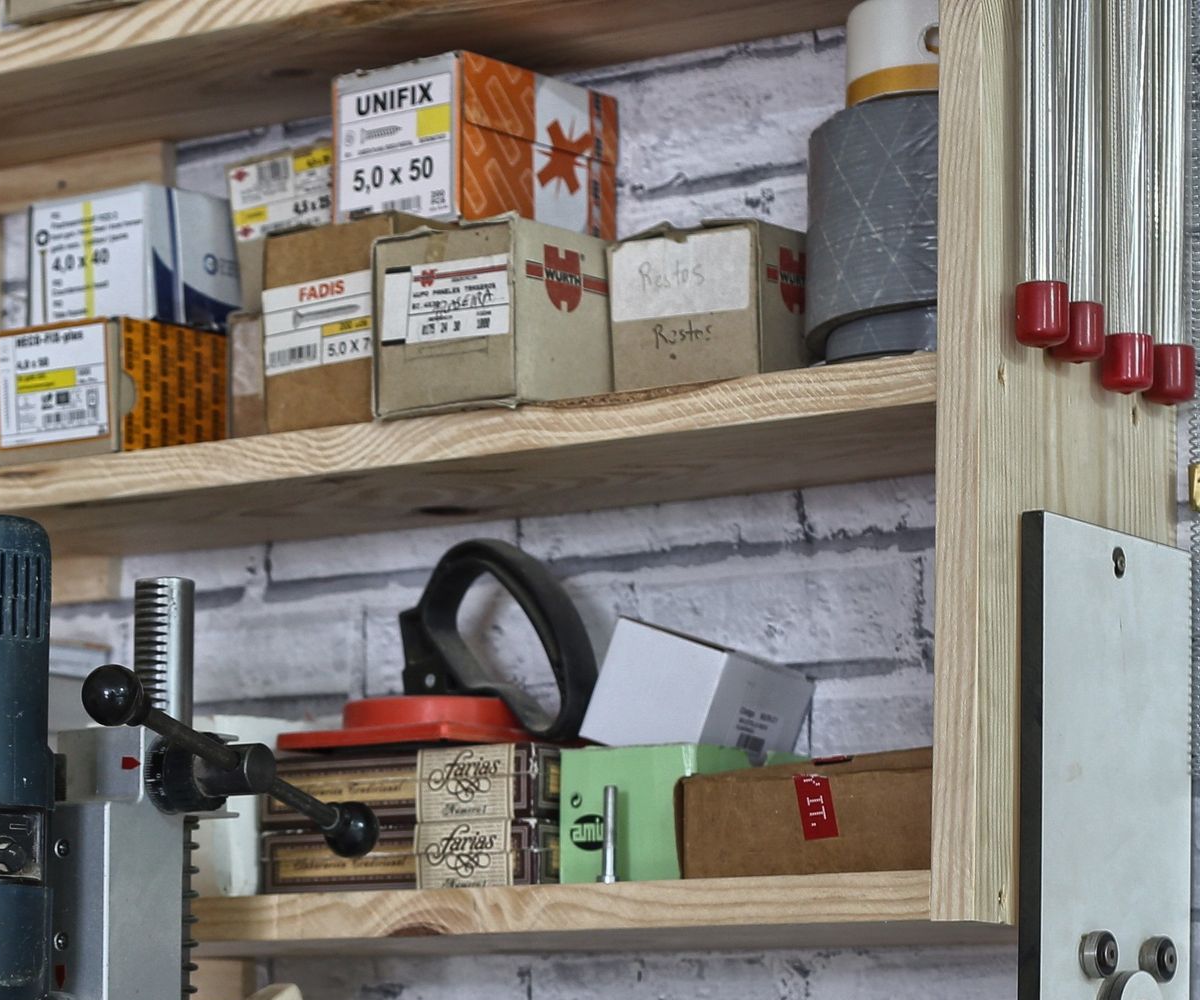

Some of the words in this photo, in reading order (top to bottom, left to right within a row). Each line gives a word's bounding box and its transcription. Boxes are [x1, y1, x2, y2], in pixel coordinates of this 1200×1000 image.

[356, 81, 433, 116] UNIFIX
[353, 165, 383, 194] 5,0
[390, 167, 402, 185] x
[409, 156, 434, 181] 50
[51, 254, 76, 273] 4,0
[92, 248, 110, 265] 40
[298, 279, 346, 302] FADIS
[638, 261, 705, 293] Restos
[652, 320, 713, 350] Restos
